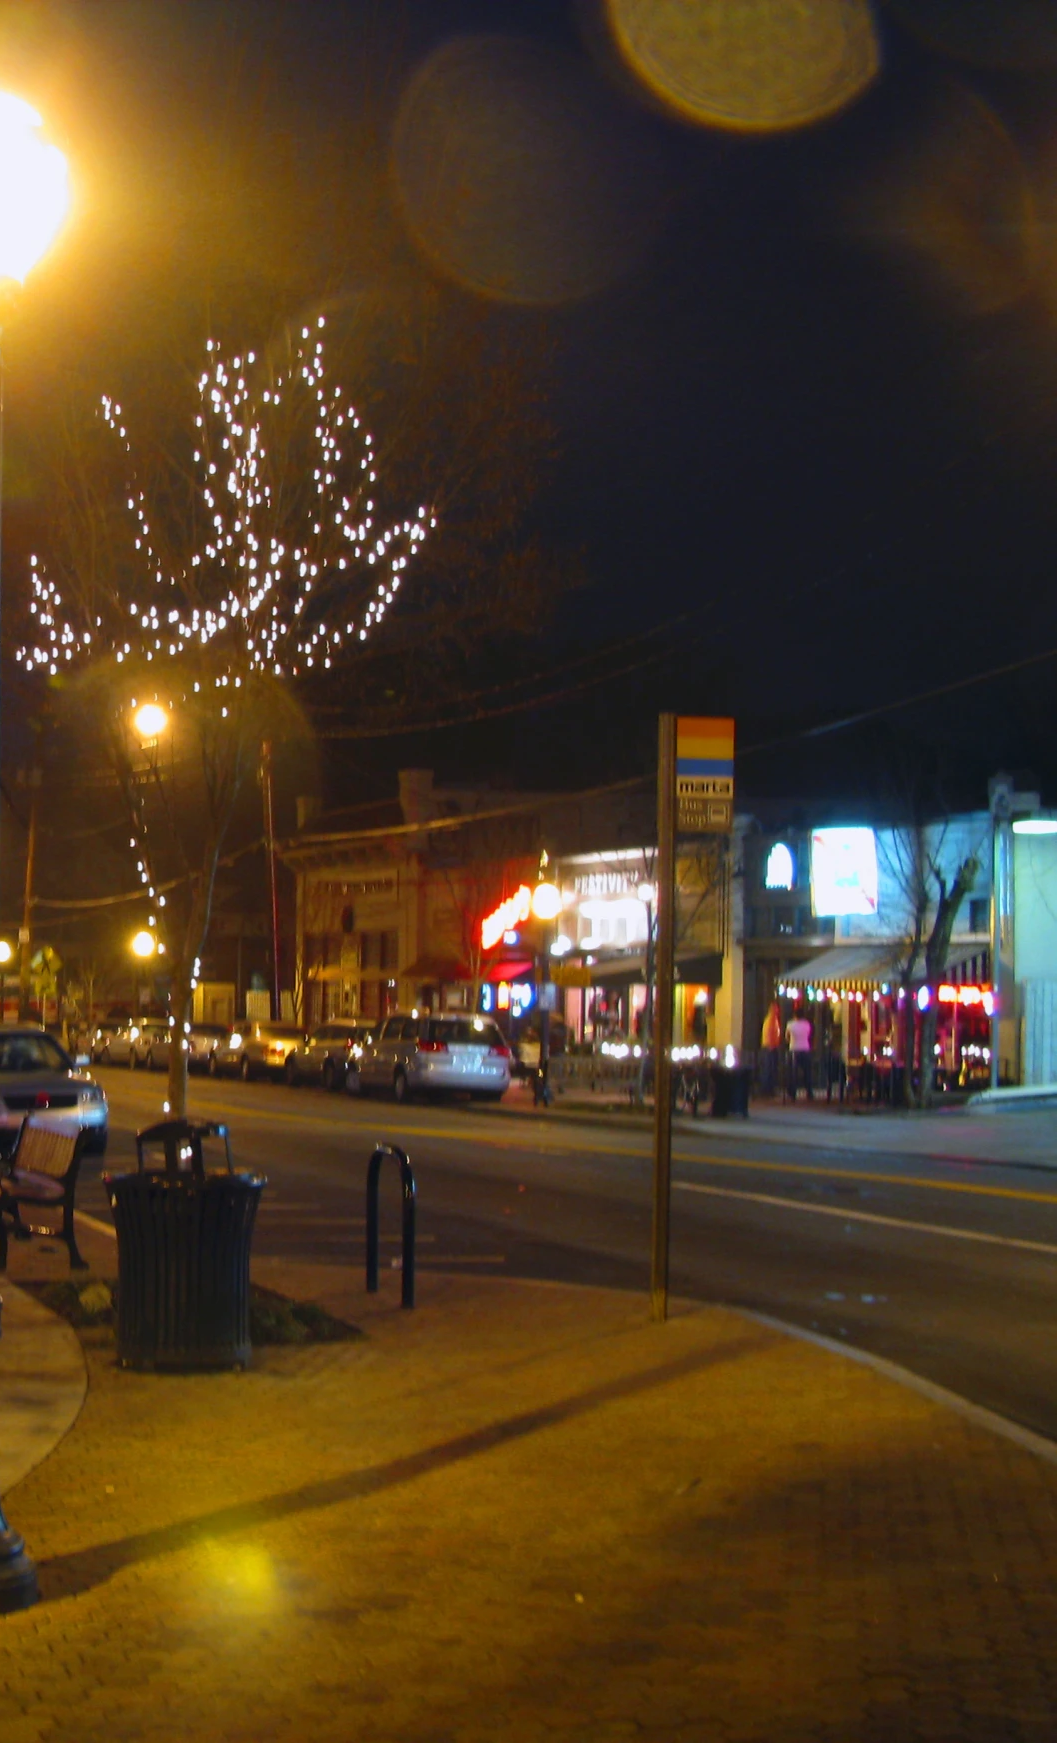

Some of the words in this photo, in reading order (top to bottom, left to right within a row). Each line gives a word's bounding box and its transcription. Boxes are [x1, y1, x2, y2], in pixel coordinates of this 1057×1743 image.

[679, 780, 730, 794] marta
[679, 798, 703, 811] Bus
[679, 812, 707, 829] Stop
